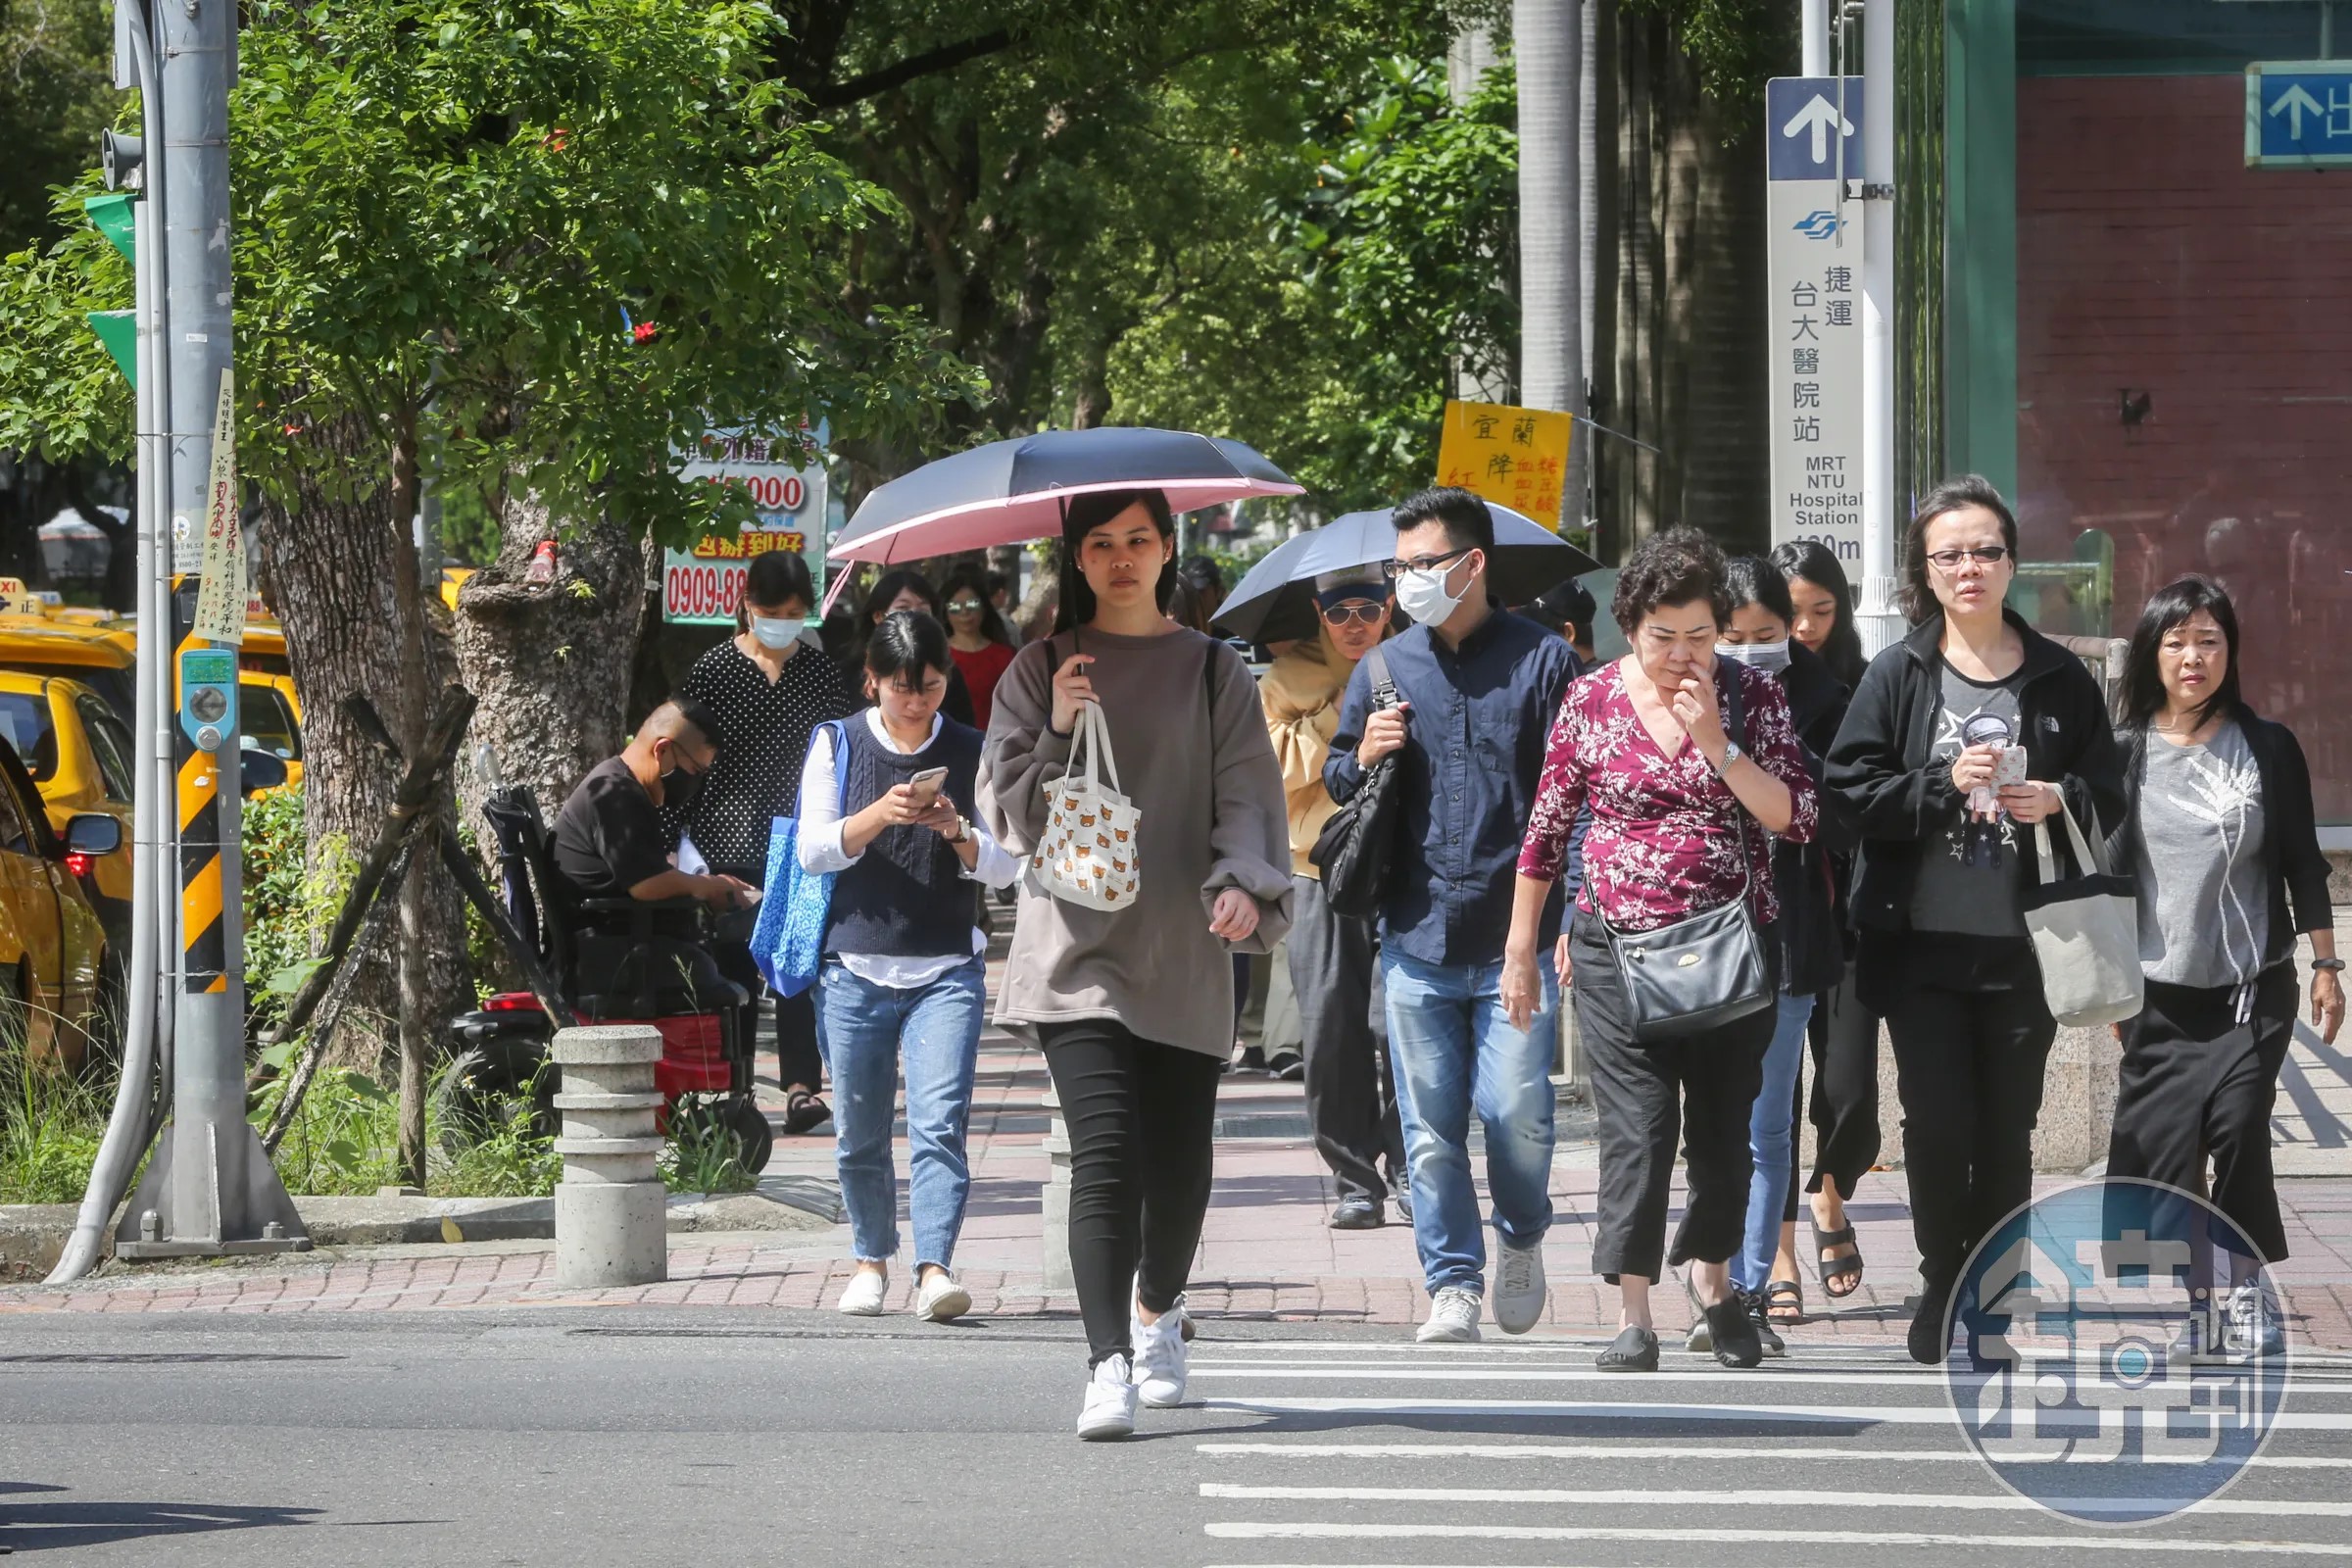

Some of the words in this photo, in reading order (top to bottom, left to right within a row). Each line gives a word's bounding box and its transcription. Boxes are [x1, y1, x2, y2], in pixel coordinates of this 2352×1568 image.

[1825, 265, 1852, 327] 捷運
[1791, 280, 1820, 443] 台大醫院站
[1472, 415, 1537, 448] 宜蘭
[1805, 456, 1846, 471] MRT
[1807, 474, 1845, 489] NTU
[1790, 492, 1864, 511] Hospital
[1795, 511, 1859, 525] Station
